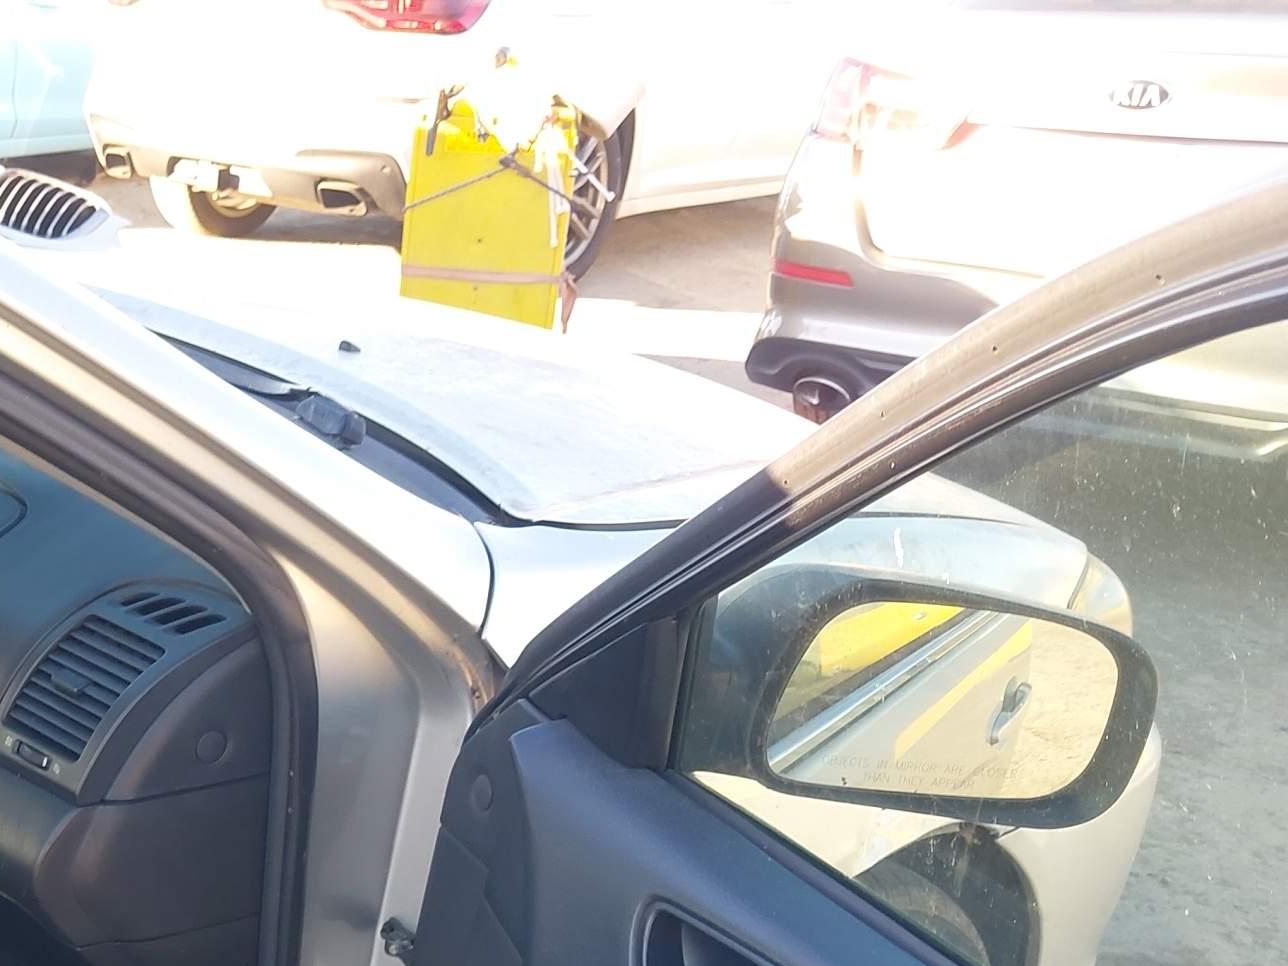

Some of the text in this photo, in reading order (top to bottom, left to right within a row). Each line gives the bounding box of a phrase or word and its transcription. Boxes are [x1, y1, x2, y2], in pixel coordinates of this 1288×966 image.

[1113, 83, 1161, 107] KIA
[876, 758, 889, 769] IN
[895, 760, 937, 773] MIRROR
[943, 765, 963, 775] ARE
[863, 771, 890, 783] THAN
[897, 775, 923, 785] THEY
